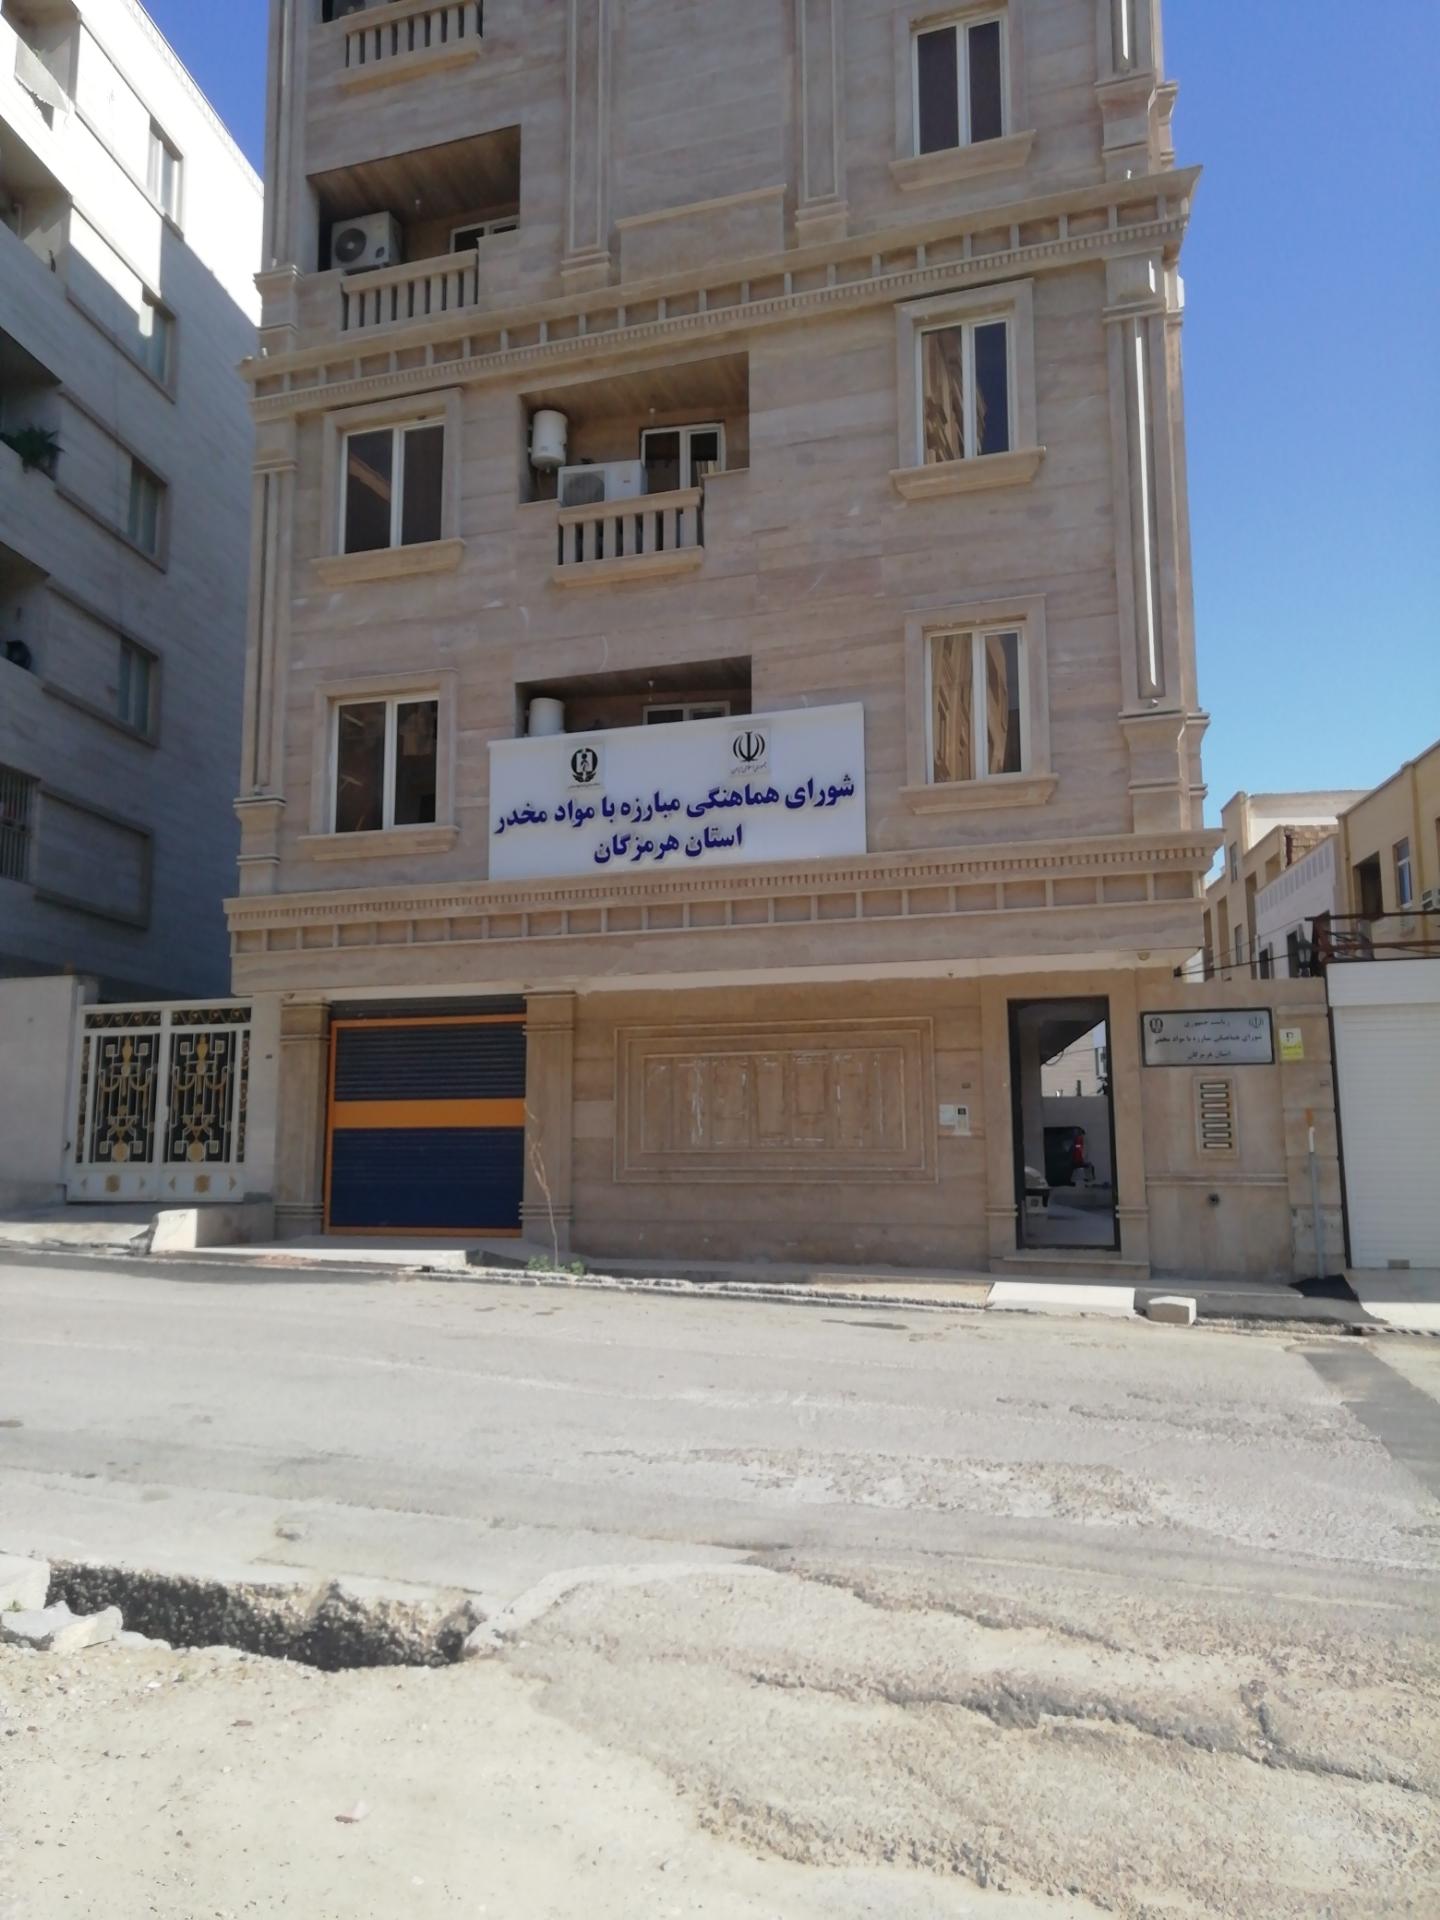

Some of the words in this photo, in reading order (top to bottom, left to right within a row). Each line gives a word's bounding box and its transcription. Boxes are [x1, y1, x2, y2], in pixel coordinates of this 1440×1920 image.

[620, 790, 681, 823] مبارزه
[686, 783, 779, 818] هماهنگی
[785, 774, 855, 809] شورای
[494, 802, 548, 834] مخدر
[554, 799, 596, 828] مواد
[601, 796, 615, 823] با
[593, 833, 680, 864] هرمزگان
[685, 823, 742, 857] استان
